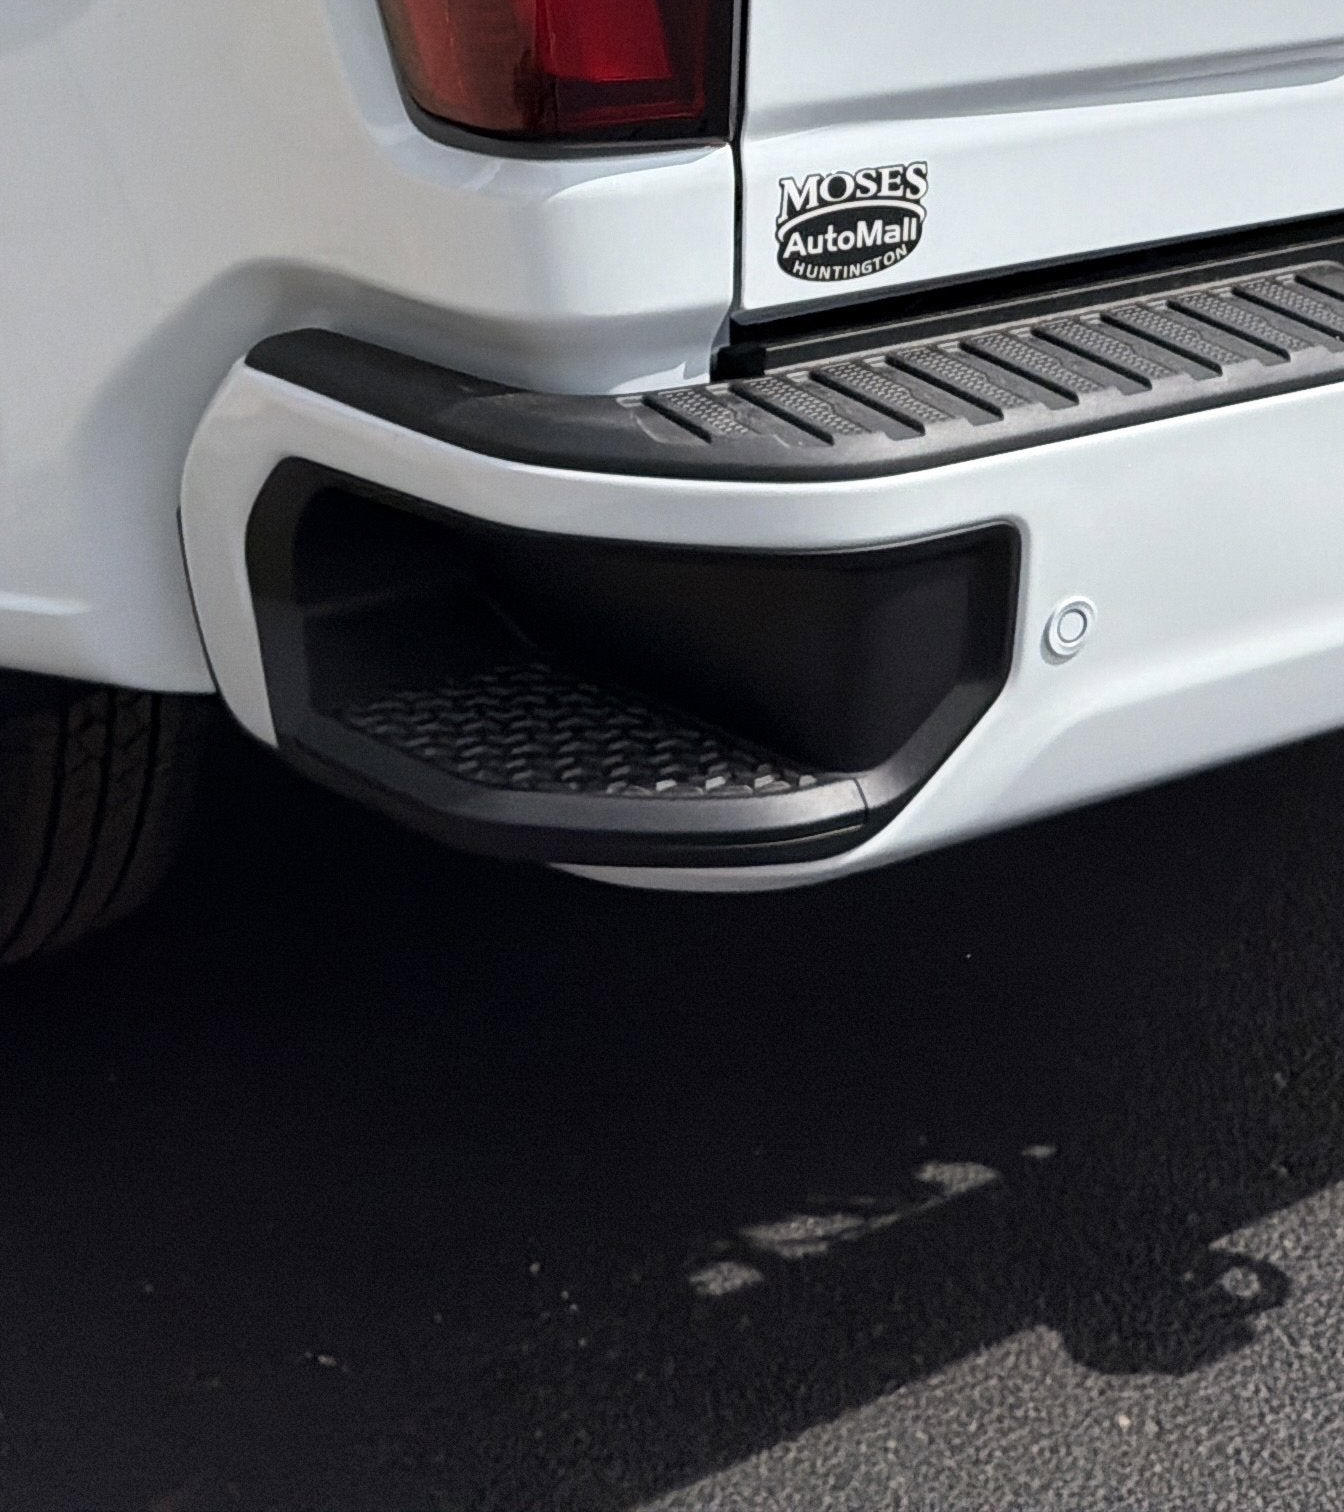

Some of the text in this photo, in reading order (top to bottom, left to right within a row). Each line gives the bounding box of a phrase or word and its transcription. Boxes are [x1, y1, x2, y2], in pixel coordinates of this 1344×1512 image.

[776, 161, 928, 225] MOSES
[782, 216, 918, 259] AutoMall
[791, 243, 909, 281] HUNTINGTON
